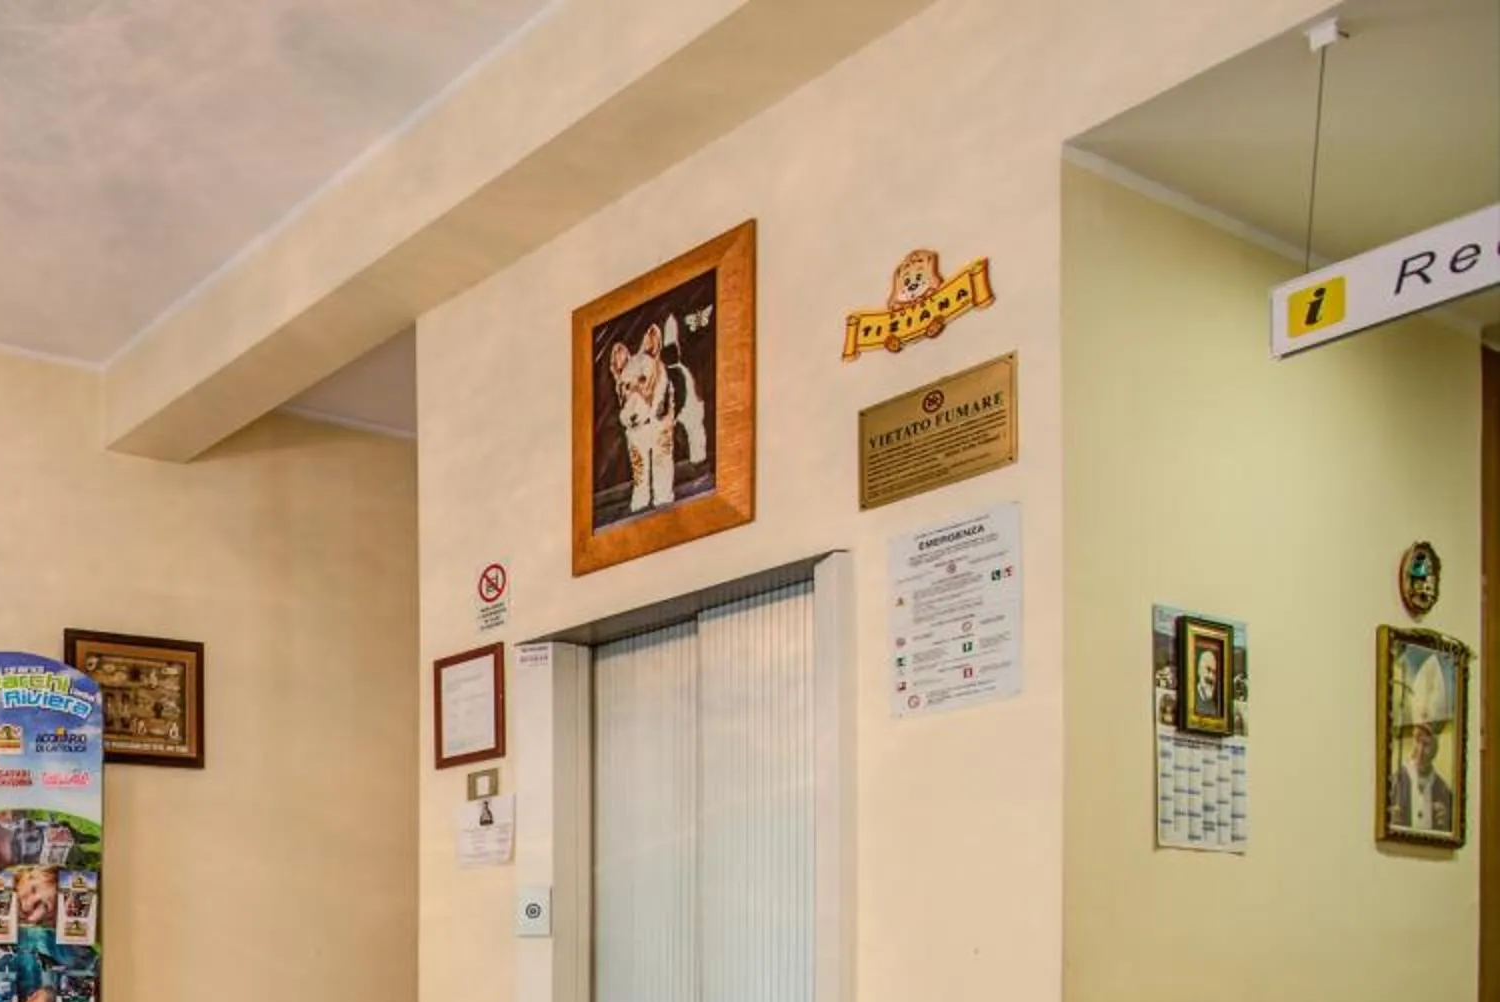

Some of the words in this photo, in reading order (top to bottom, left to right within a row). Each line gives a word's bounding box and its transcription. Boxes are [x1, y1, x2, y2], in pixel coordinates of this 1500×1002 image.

[1394, 241, 1500, 295] Re
[862, 287, 969, 338] TIZIANA
[868, 418, 932, 449] VIETATO
[934, 390, 1005, 427] FUMARE
[918, 523, 986, 551] EMERGENZA
